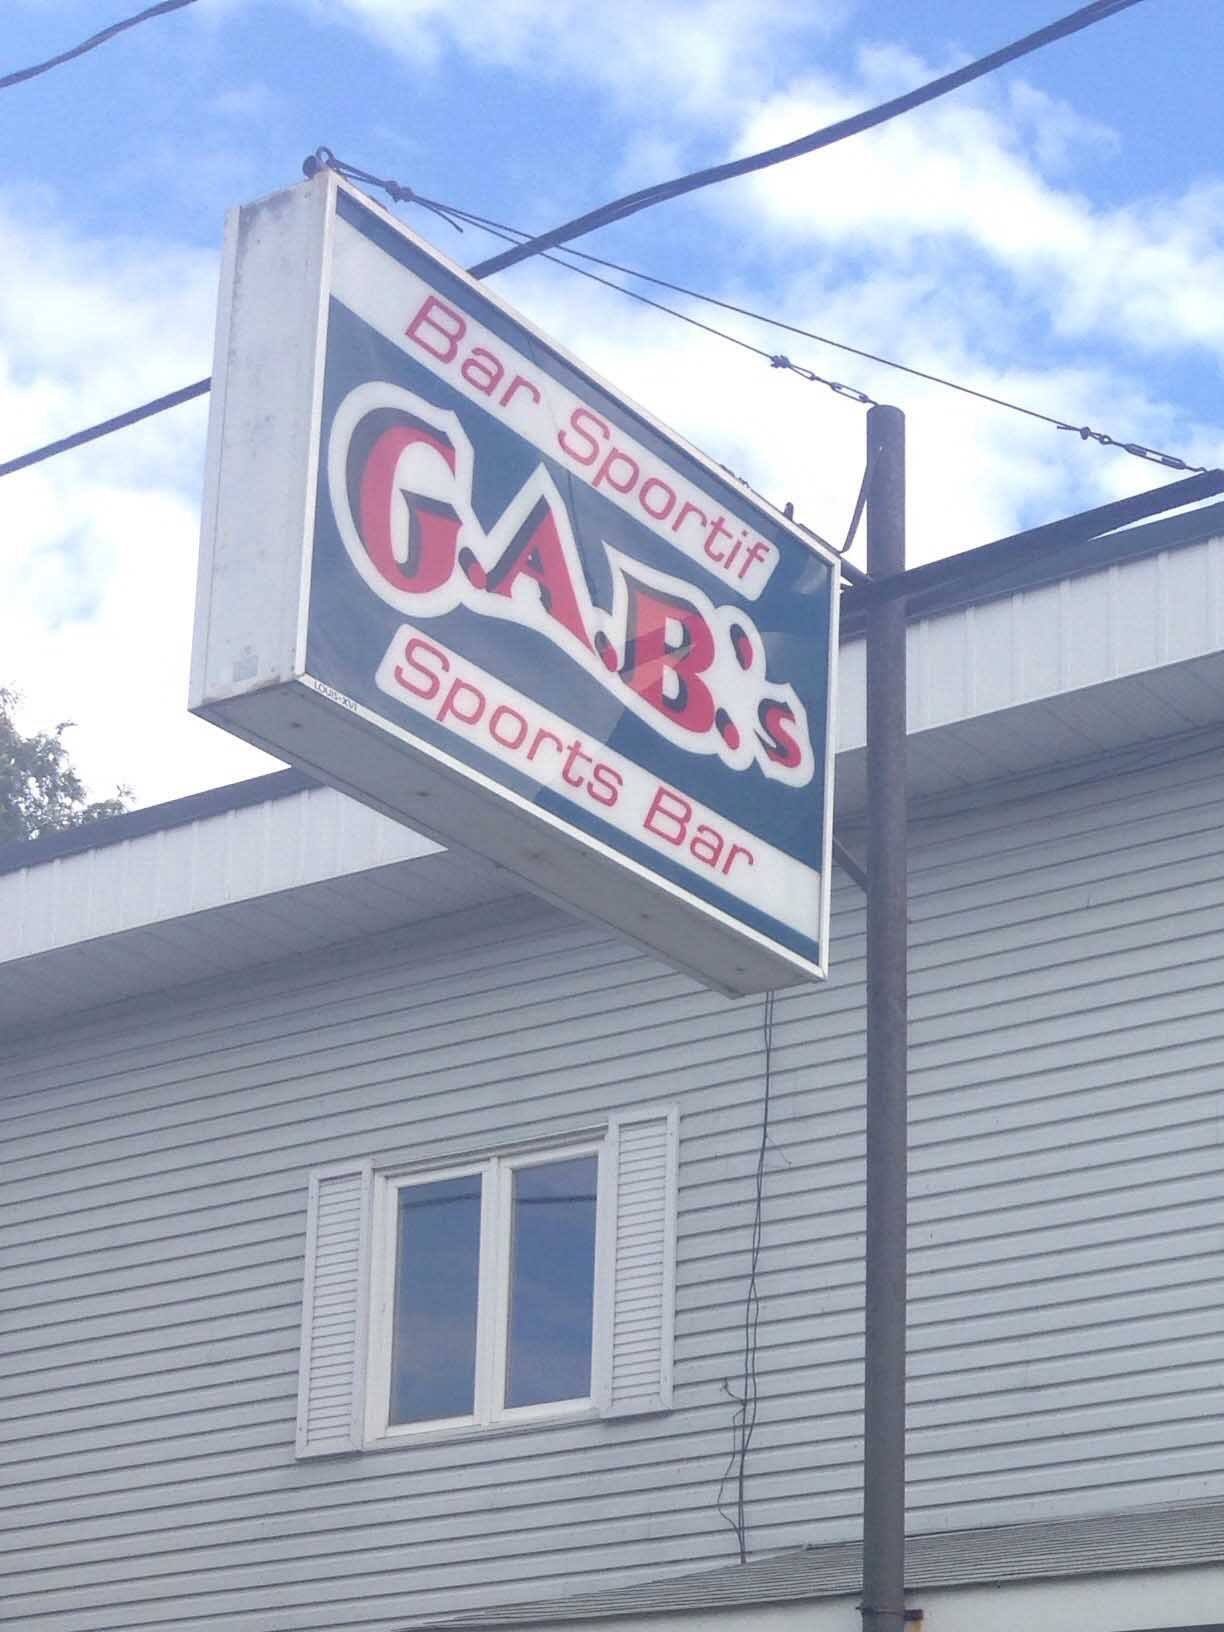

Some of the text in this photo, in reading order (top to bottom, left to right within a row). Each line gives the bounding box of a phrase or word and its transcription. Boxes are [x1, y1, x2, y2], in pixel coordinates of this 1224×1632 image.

[405, 295, 770, 579] Bar Sportif
[393, 637, 755, 875] Sports Bar
